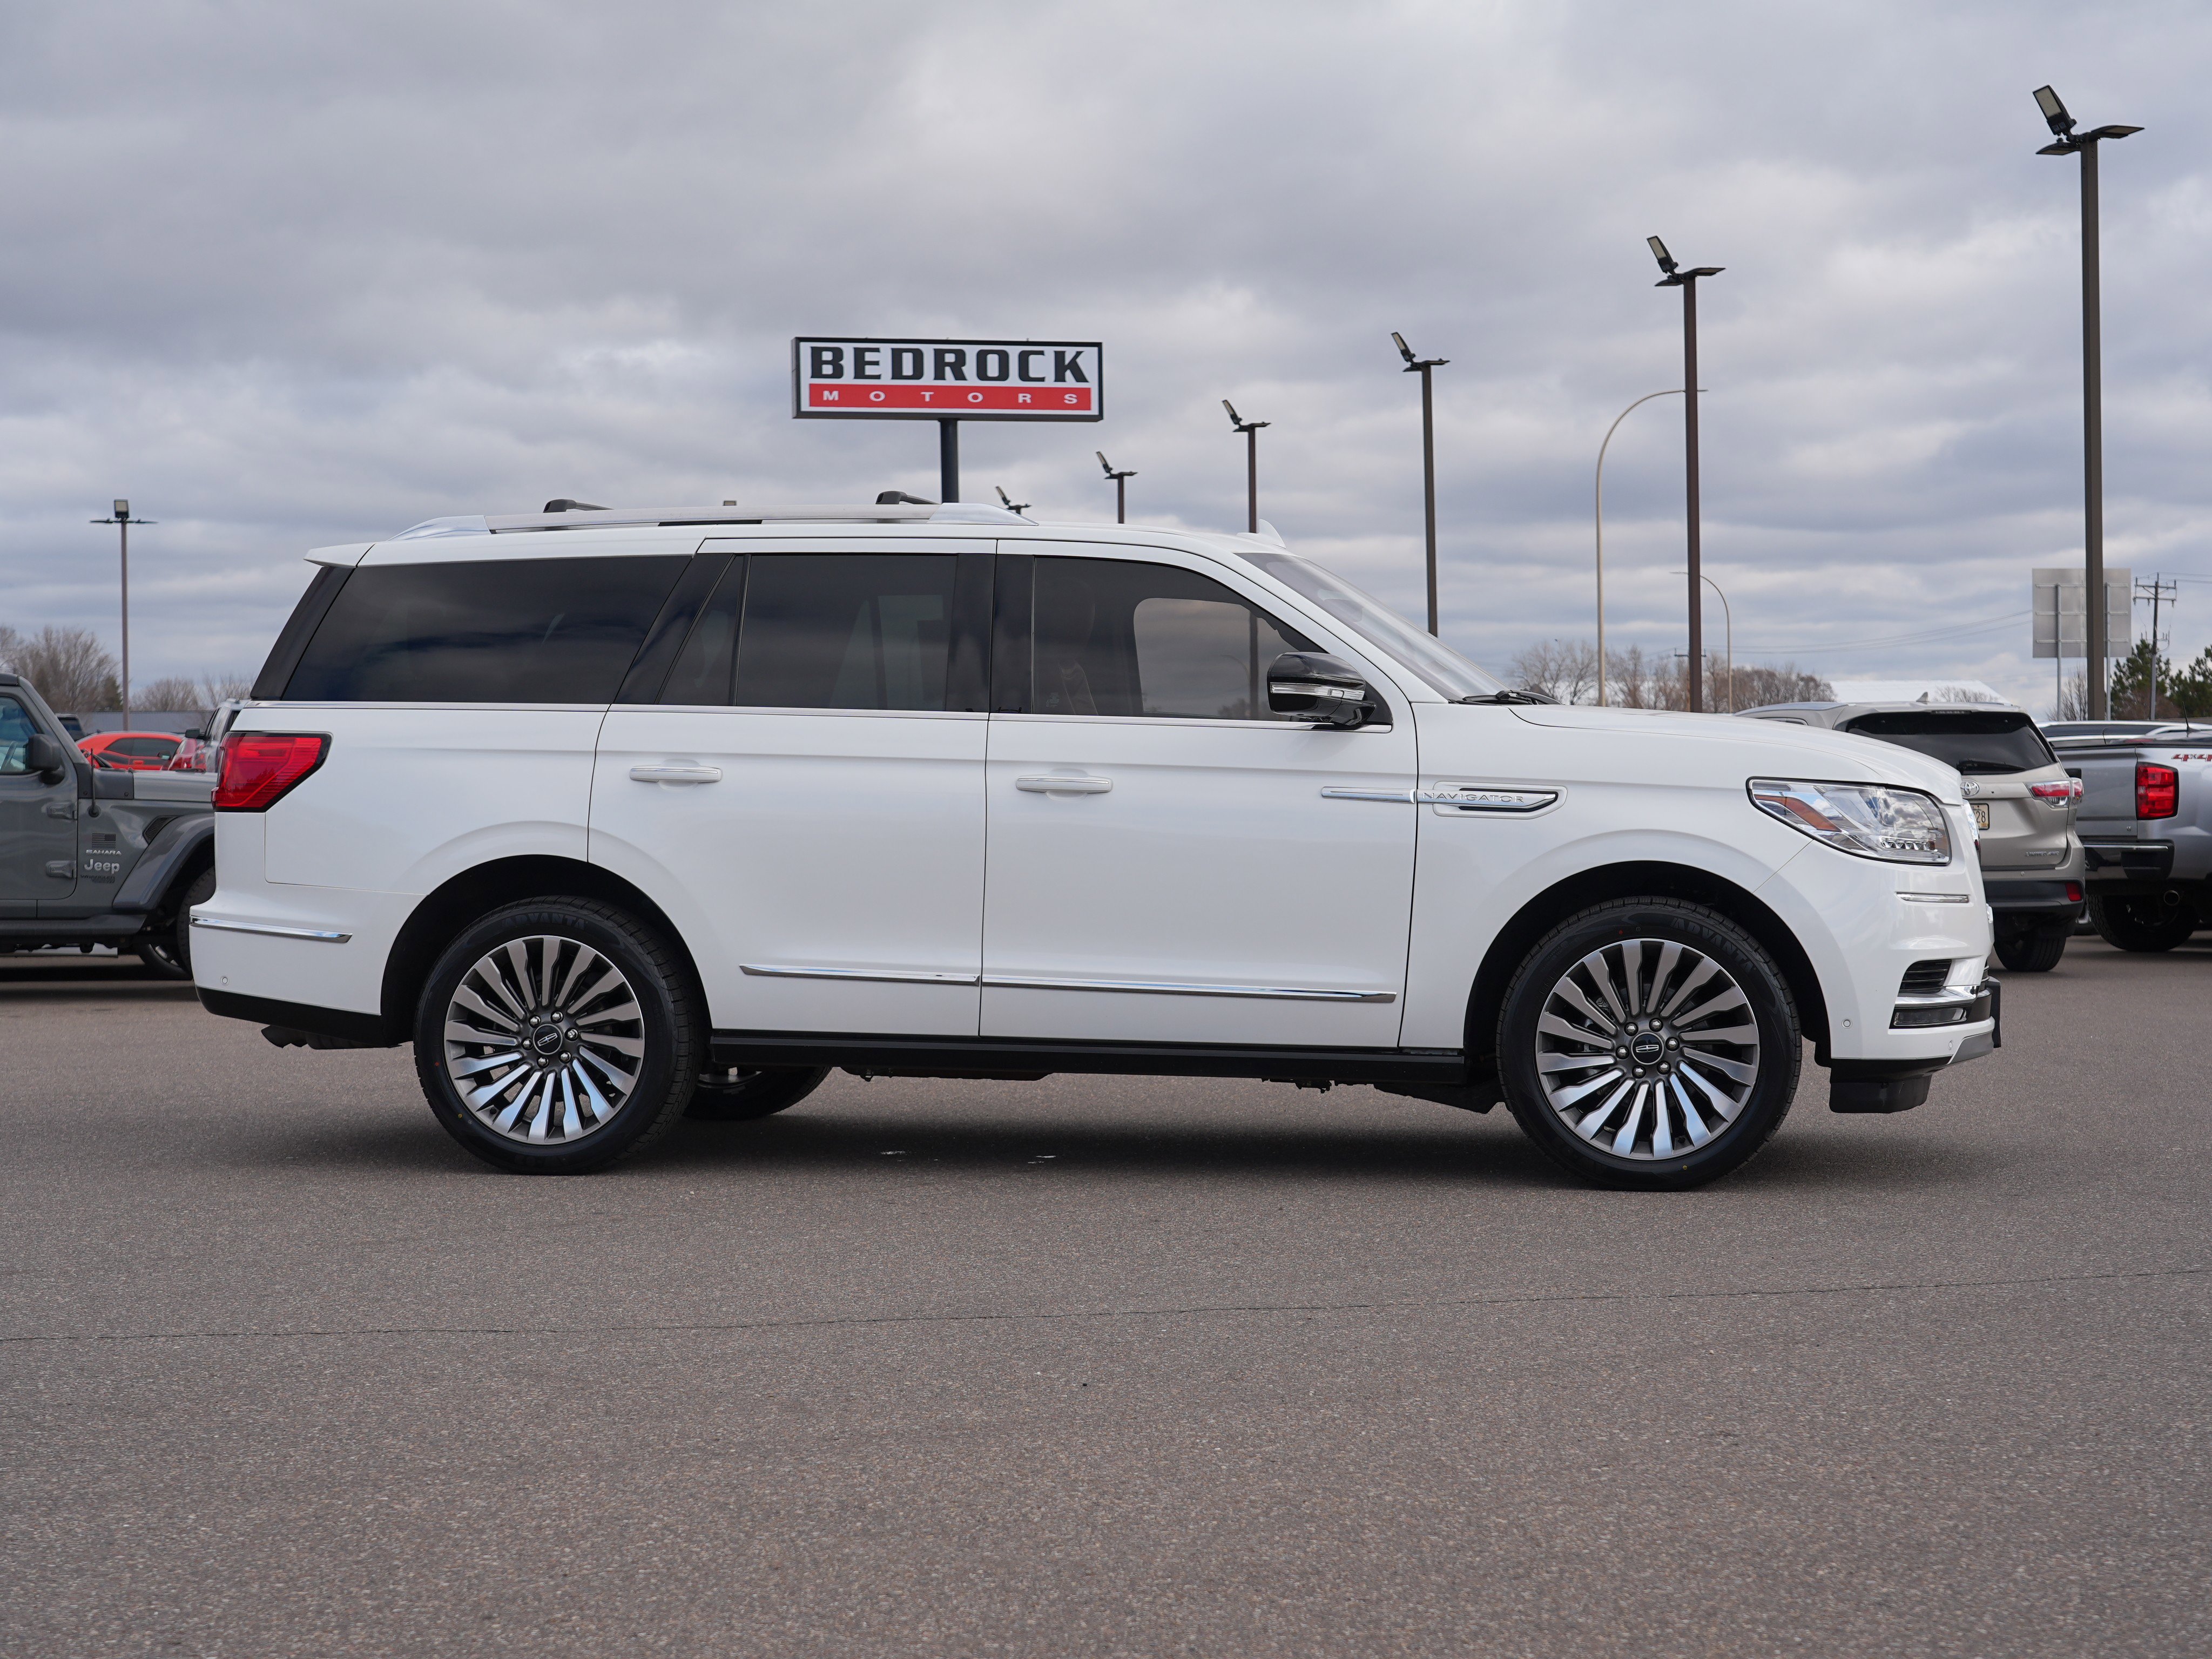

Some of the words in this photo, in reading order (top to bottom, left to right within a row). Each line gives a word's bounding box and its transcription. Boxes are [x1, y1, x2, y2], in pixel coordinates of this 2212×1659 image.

[810, 346, 1089, 383] BEDROCK
[822, 390, 1077, 404] MOTORS
[1422, 792, 1525, 803] NAVIGATOR
[1973, 811, 1986, 823] 28
[84, 859, 120, 874] Jeep
[502, 912, 586, 930] ADVANTA
[1671, 918, 1754, 973] ADVANTA
